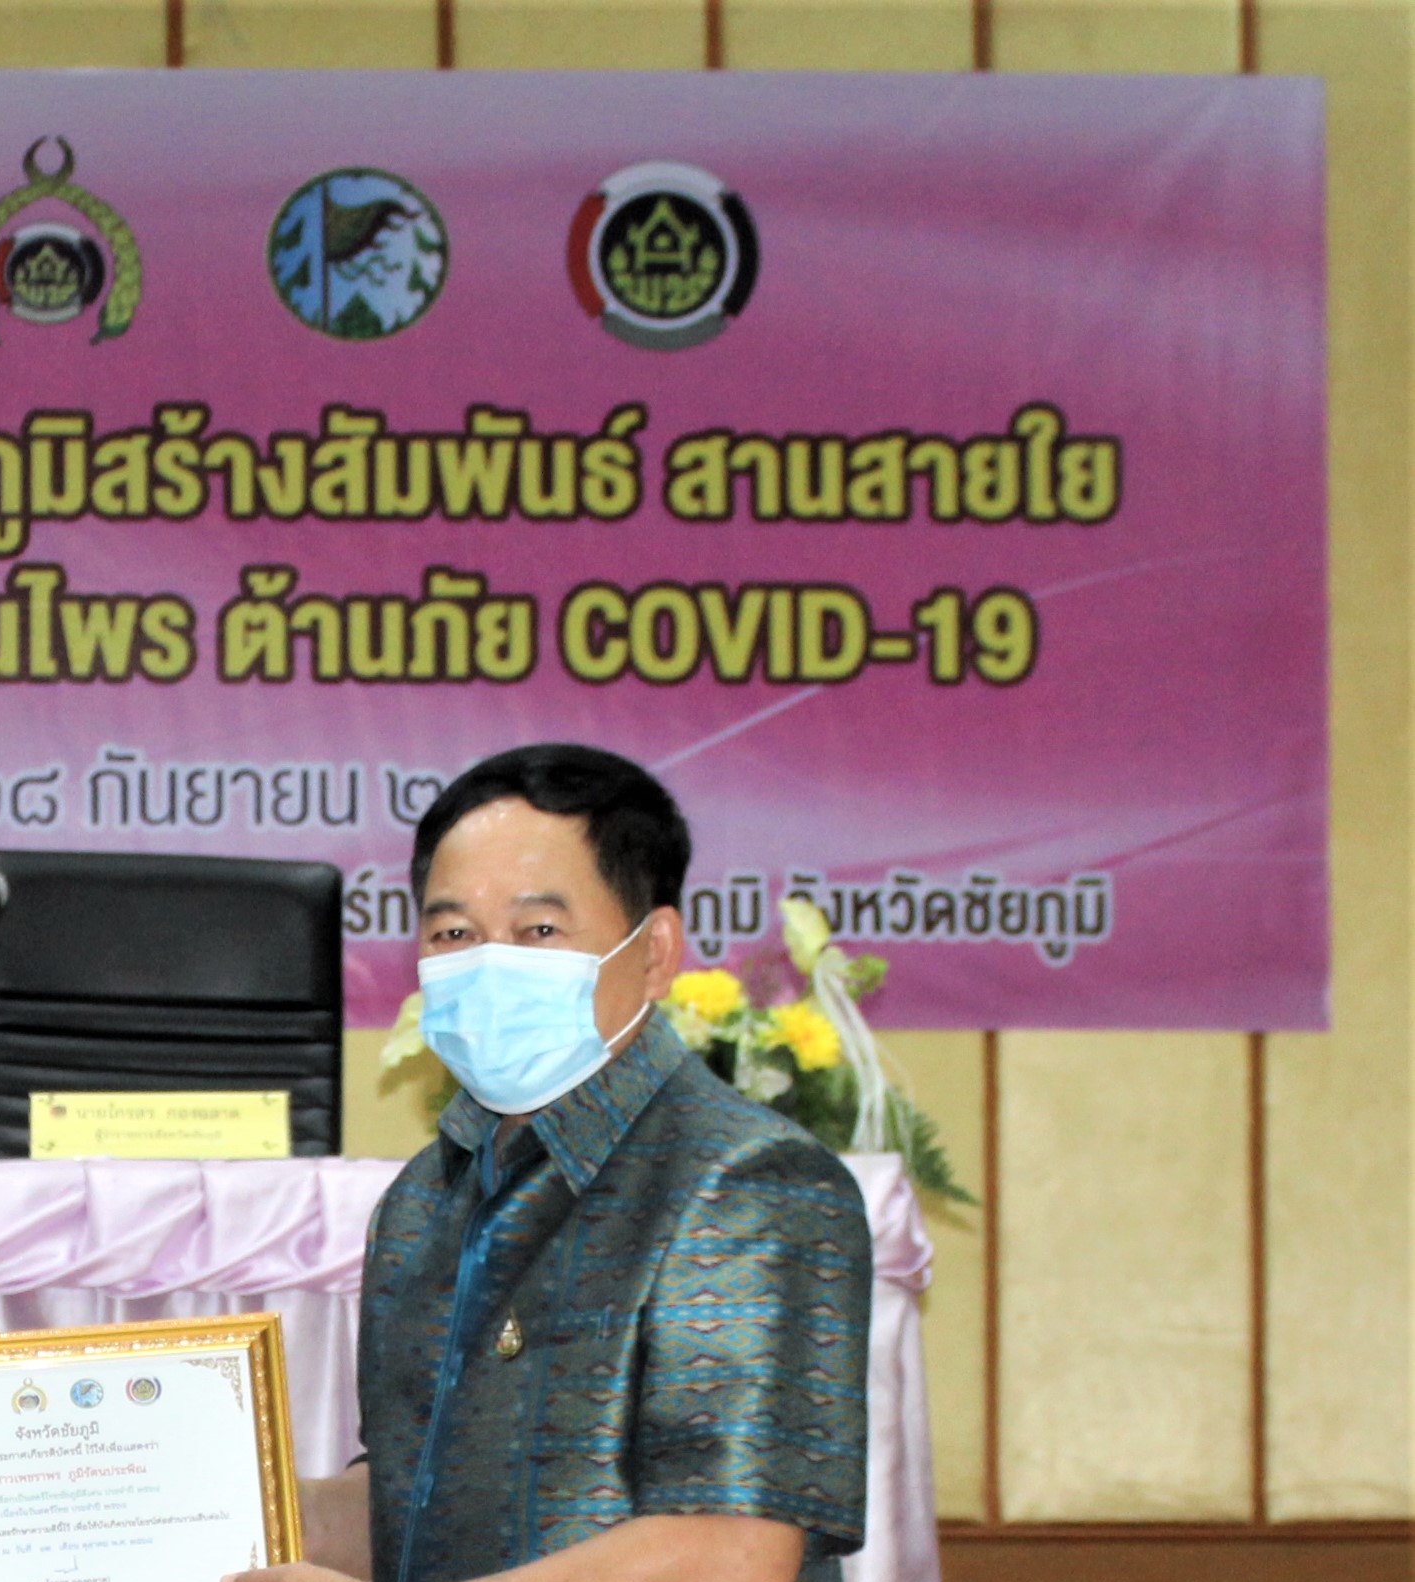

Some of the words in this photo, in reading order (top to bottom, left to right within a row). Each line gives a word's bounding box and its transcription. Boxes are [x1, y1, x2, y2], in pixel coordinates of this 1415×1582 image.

[665, 402, 1121, 523] สานสายใย
[218, 566, 535, 684] ต้านภัย
[561, 582, 1037, 684] COVID-19
[89, 749, 359, 827] กันยายน
[789, 873, 1106, 959] ังหวัดชัยภูมิ
[15, 1420, 100, 1441] จังหวัดชัยภูมิ
